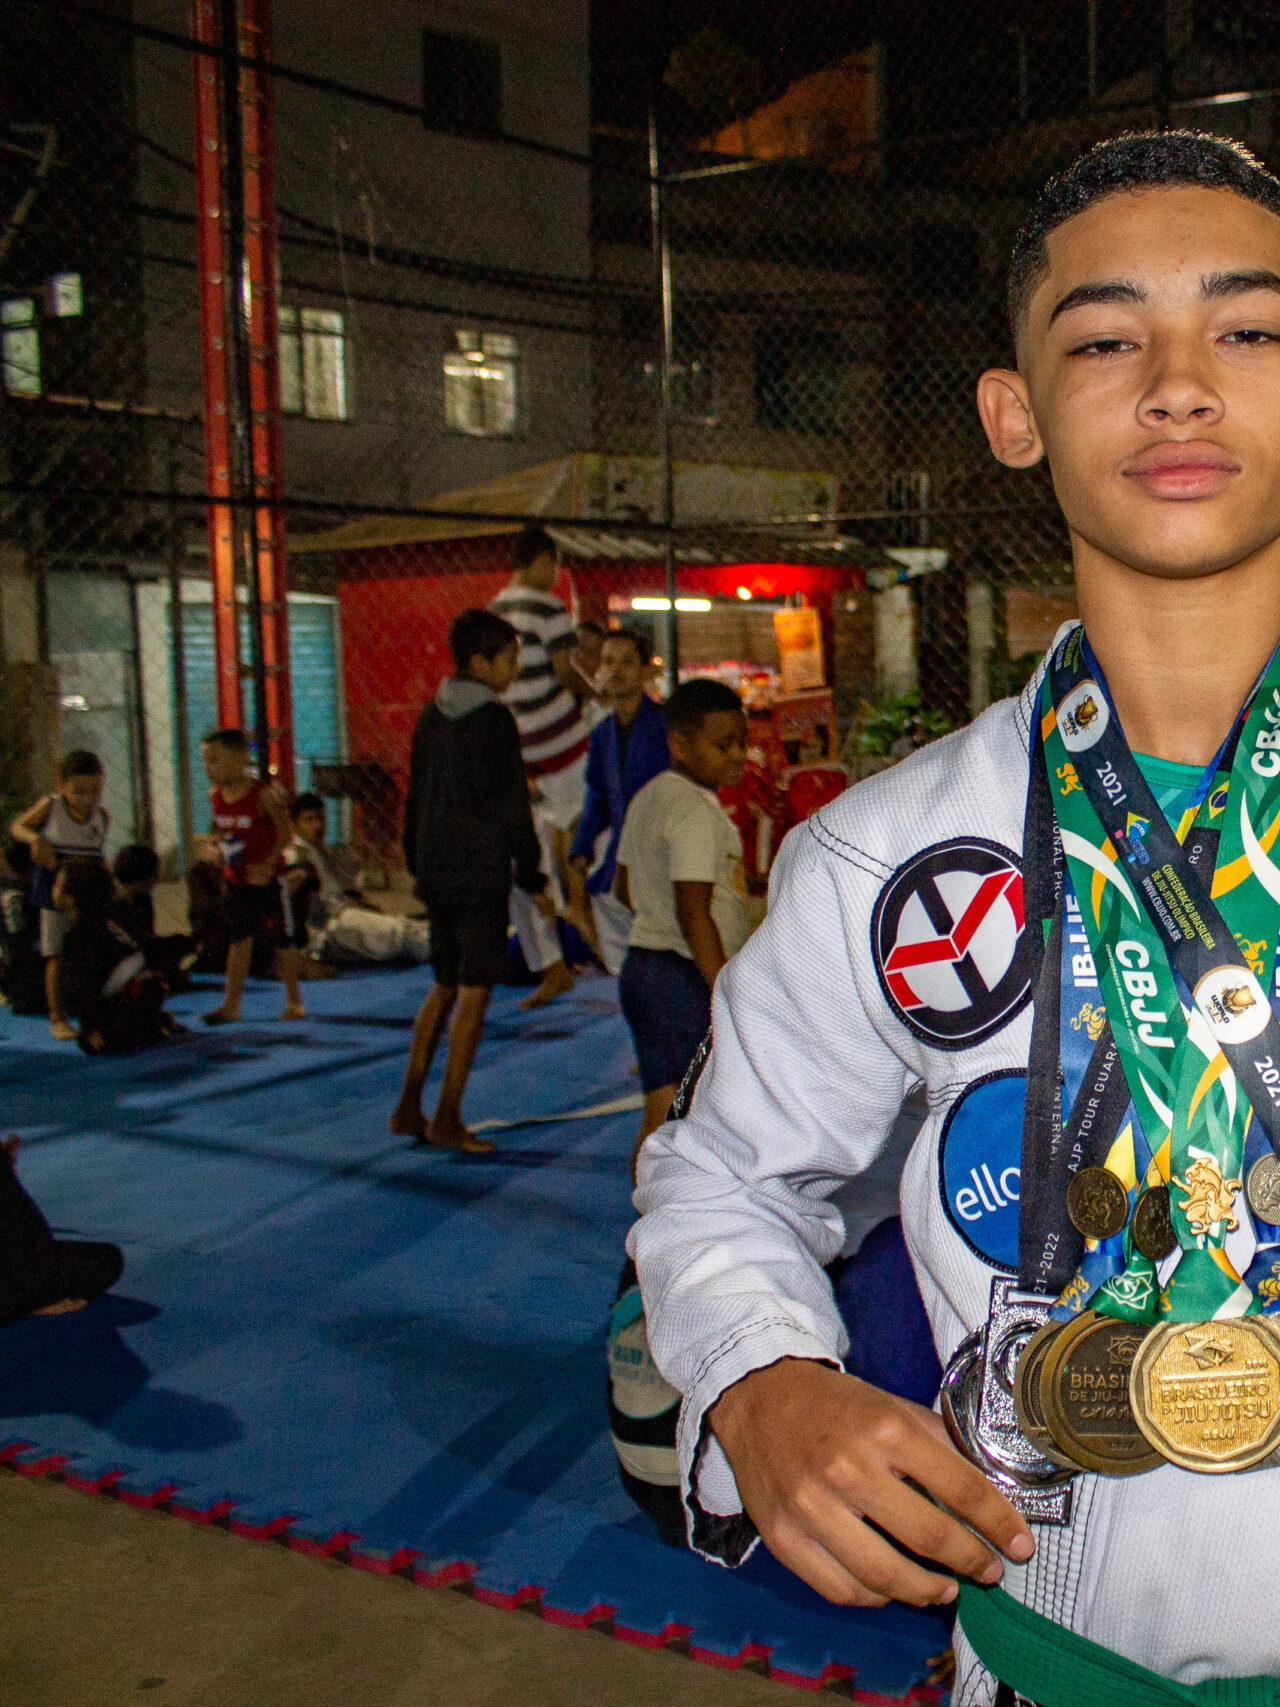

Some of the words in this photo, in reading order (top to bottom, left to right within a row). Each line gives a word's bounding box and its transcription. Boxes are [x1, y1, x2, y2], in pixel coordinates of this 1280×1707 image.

[1096, 761, 1127, 806] 2021
[1151, 870, 1163, 882] DE
[1142, 876, 1181, 942] WWW.CBJJO.COM.BR
[1156, 880, 1178, 909] JIU-JITSU
[1162, 864, 1195, 913] CONFEDERAÇÃO
[1189, 911, 1216, 951] BRASILEIRA
[1172, 907, 1195, 940] OLÍMPICO
[1115, 939, 1175, 1049] CBJJ
[1211, 994, 1230, 1025] WORLD
[1067, 1143, 1082, 1173] AJP
[1078, 1098, 1100, 1138] TOUR
[1070, 1391, 1088, 1402] DE
[1161, 1381, 1270, 1403] BRASILEIRO
